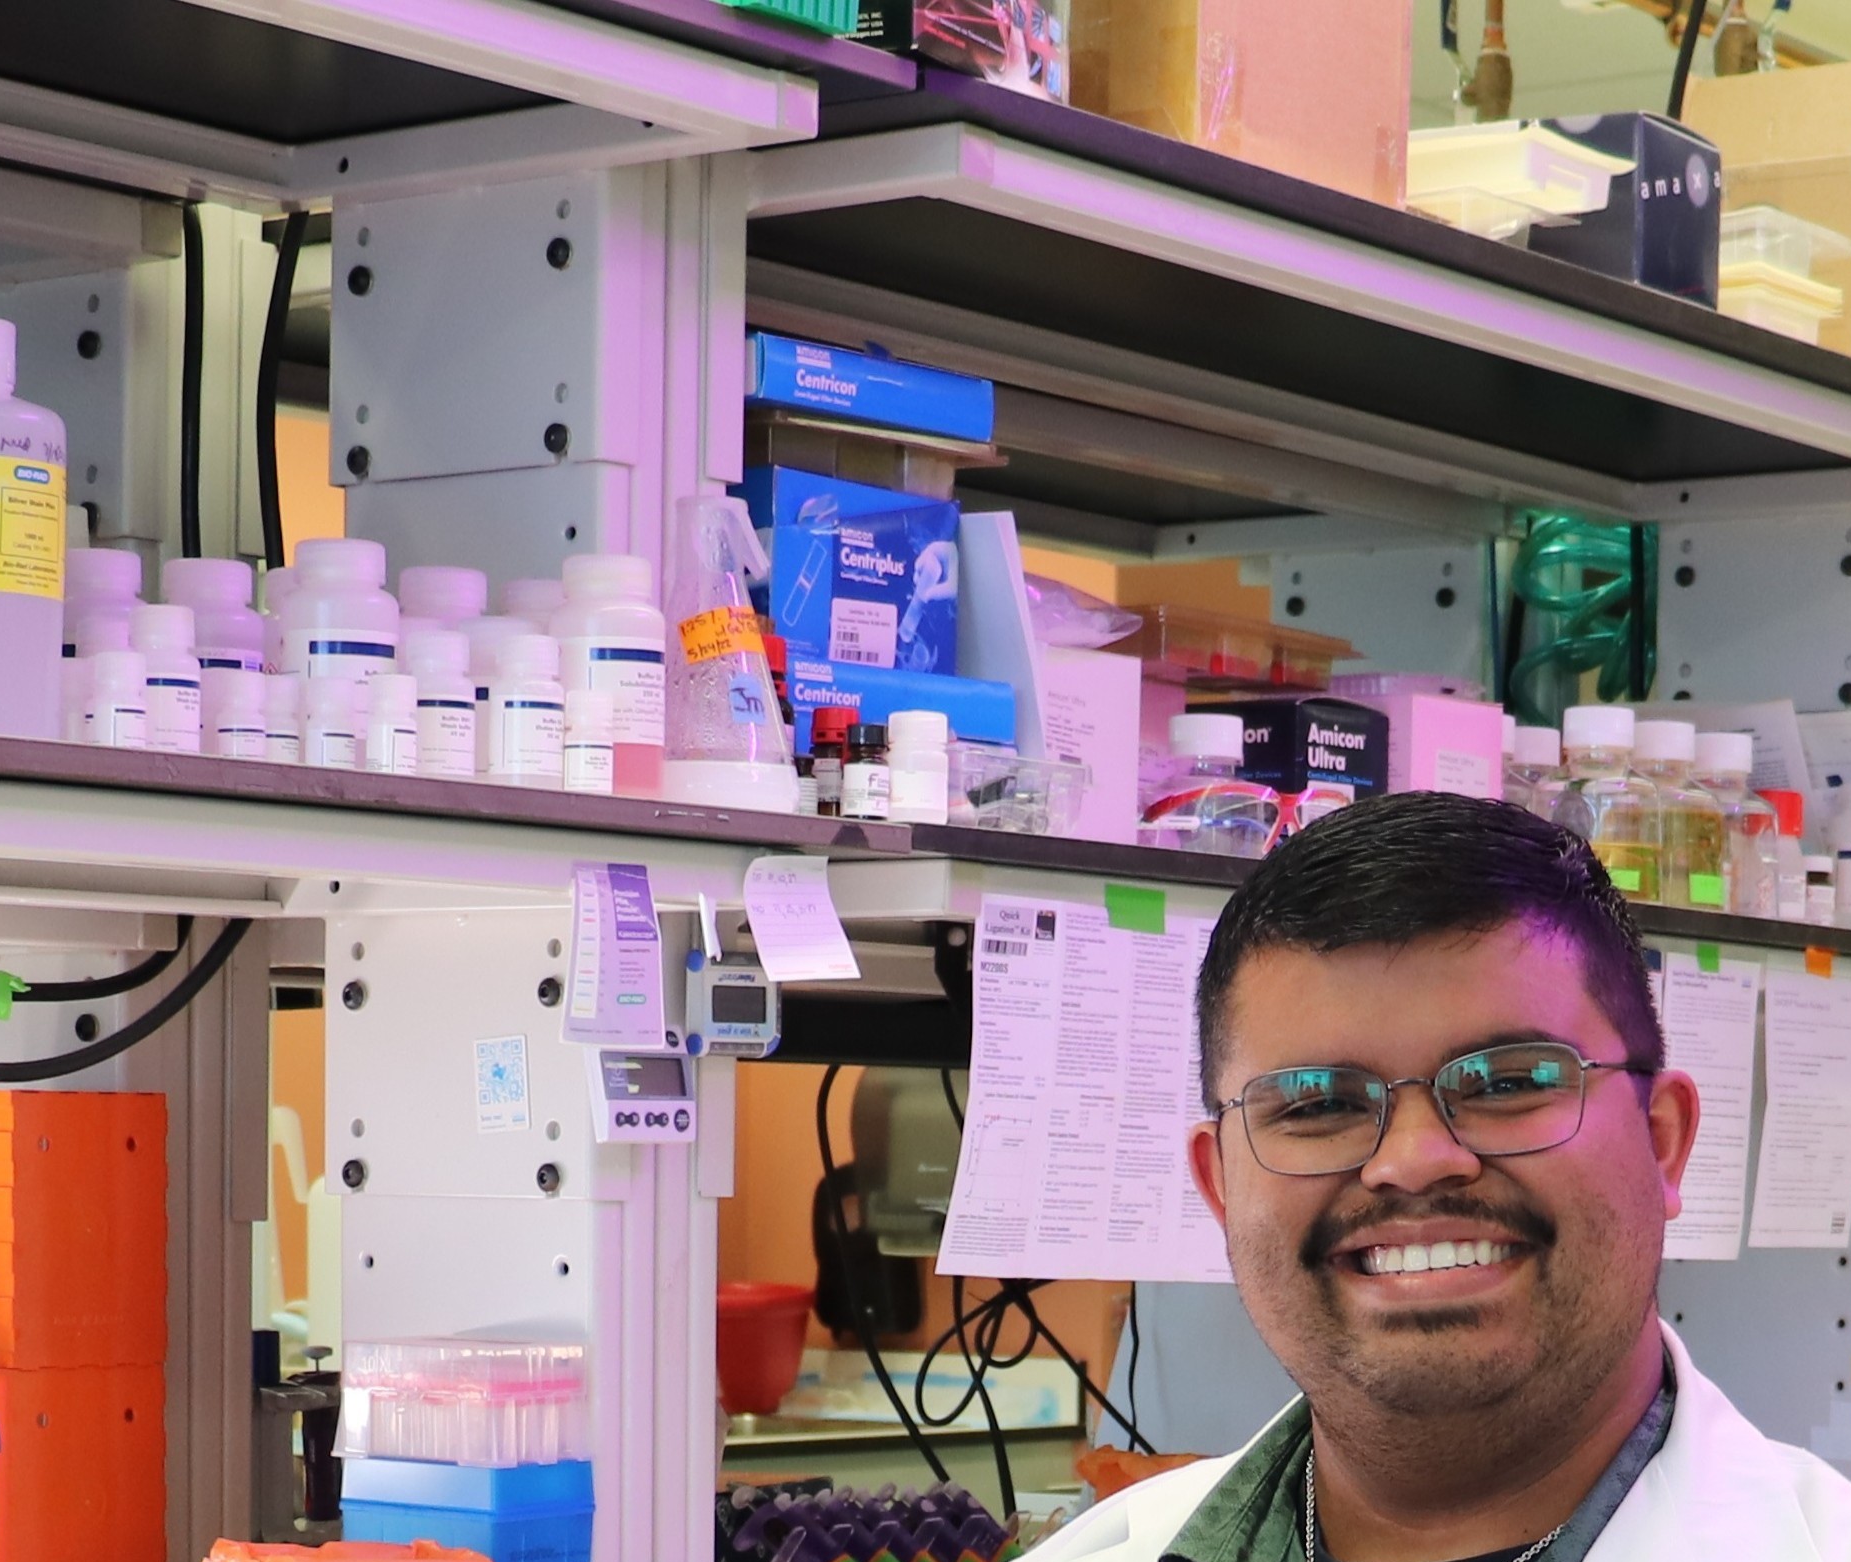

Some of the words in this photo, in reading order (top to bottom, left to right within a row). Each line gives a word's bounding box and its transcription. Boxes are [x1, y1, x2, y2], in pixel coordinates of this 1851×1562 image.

[795, 368, 857, 397] Centricon
[16, 468, 49, 482] BIO-RAD
[840, 547, 905, 578] Centriplus
[794, 682, 861, 707] Centricon
[1307, 721, 1365, 751] Amicon
[1307, 745, 1347, 772] Ultra
[999, 910, 1020, 922] Quick
[1020, 925, 1031, 936] Kit
